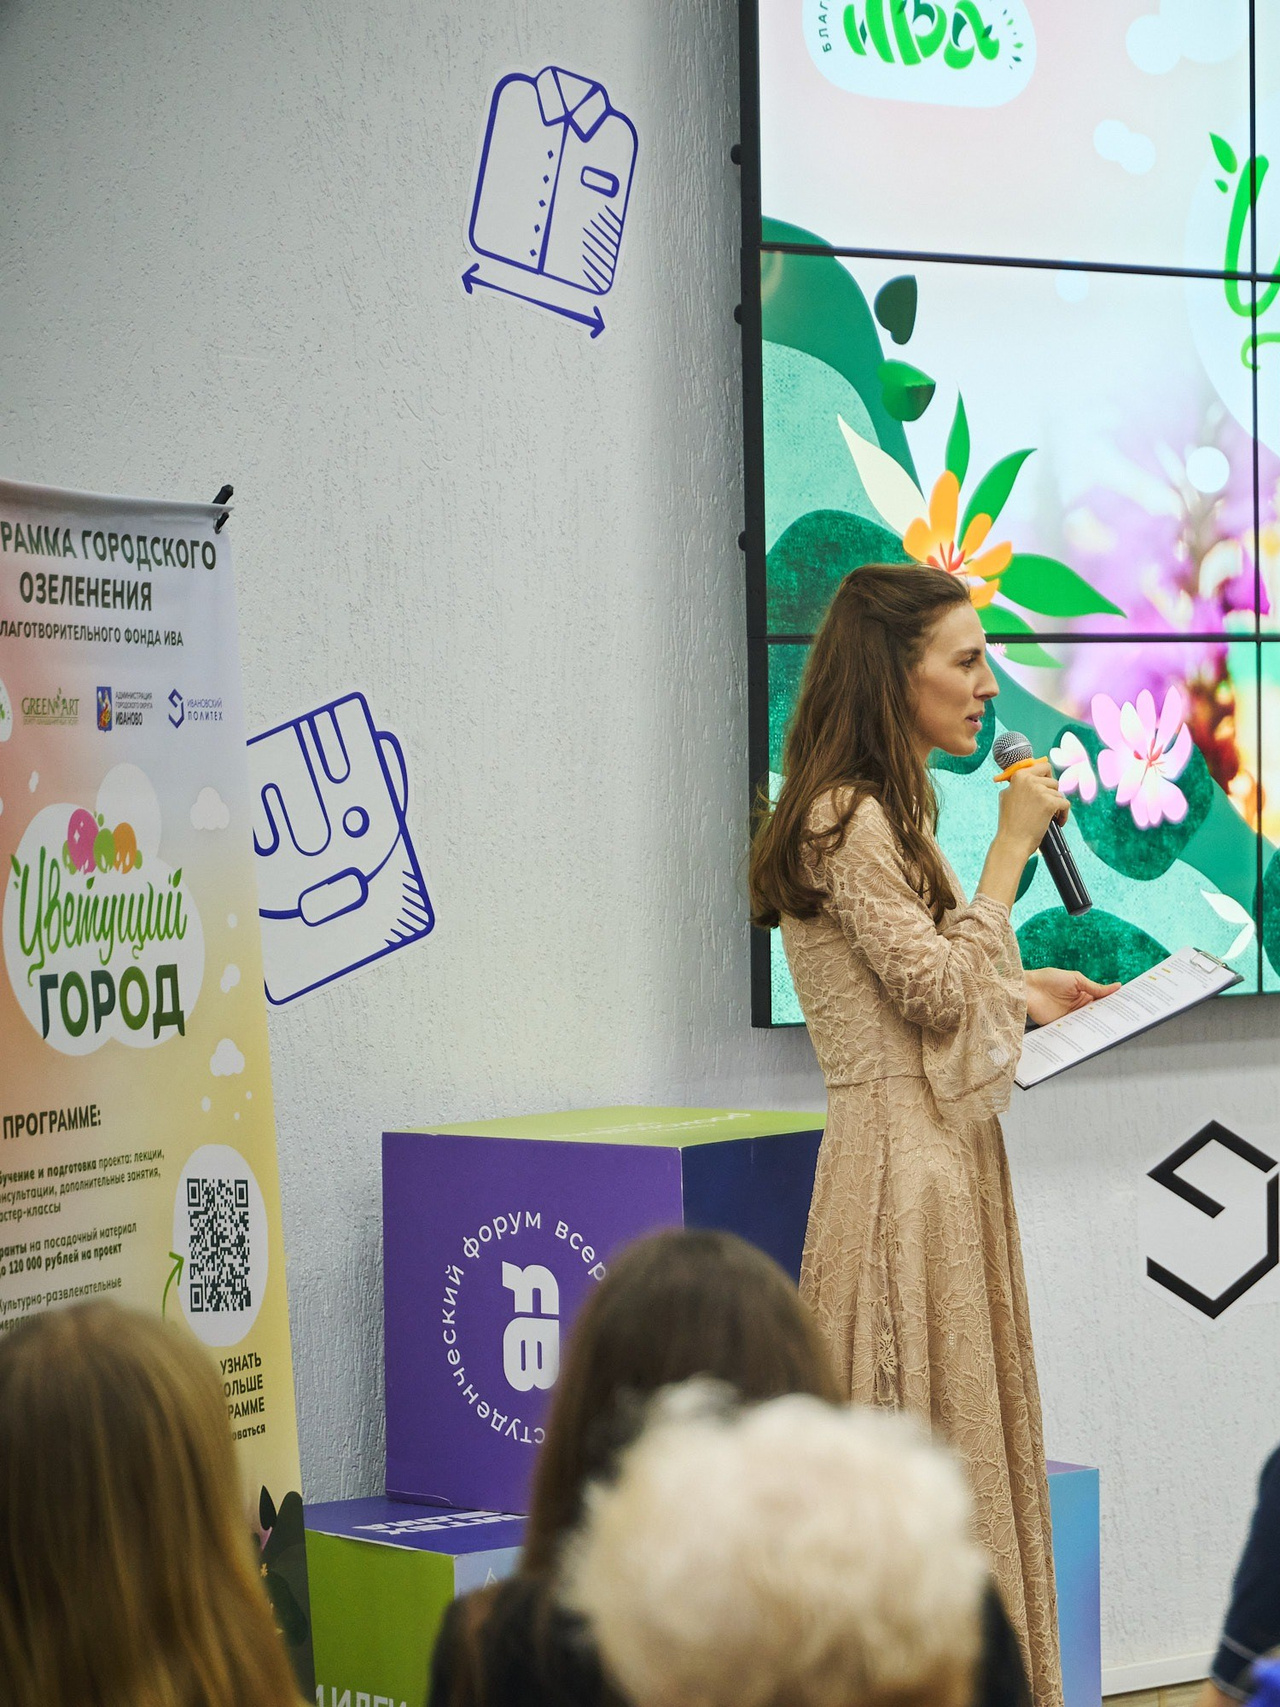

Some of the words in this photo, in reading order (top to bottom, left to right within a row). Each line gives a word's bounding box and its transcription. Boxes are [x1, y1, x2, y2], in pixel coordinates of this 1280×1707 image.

[82, 530, 217, 572] ГОРОДСКОГО
[20, 571, 152, 611] ОЗЕЛЕНЕНИЯ
[124, 627, 161, 648] ФОНДА
[164, 631, 184, 646] ИВА
[187, 697, 223, 708] ИВАНОВСКИЙ
[188, 711, 223, 721] ПОЛИТЕХ
[115, 712, 143, 725] ИВАНОВО
[18, 846, 188, 987] Цветущий
[39, 963, 185, 1040] ГОРОД
[3, 1104, 101, 1139] ПРОГРАММЕ:
[38, 1167, 44, 1178] и
[47, 1159, 97, 1178] подготовка
[98, 1154, 132, 1171] проекта:
[134, 1149, 165, 1163] лекции,
[60, 1172, 125, 1196] дополнительные
[127, 1167, 161, 1181] занятия,
[30, 1239, 41, 1251] на
[44, 1228, 98, 1249] посадочный
[100, 1222, 137, 1239] материал
[463, 1211, 541, 1259] форум
[554, 1220, 607, 1281] всер
[9, 1259, 23, 1274] 120
[26, 1257, 42, 1270] 000
[45, 1250, 79, 1271] рублей
[82, 1248, 92, 1260] на
[94, 1243, 122, 1260] проект
[220, 1352, 262, 1375] УЗНАТЬ
[442, 1265, 546, 1444] студенческий
